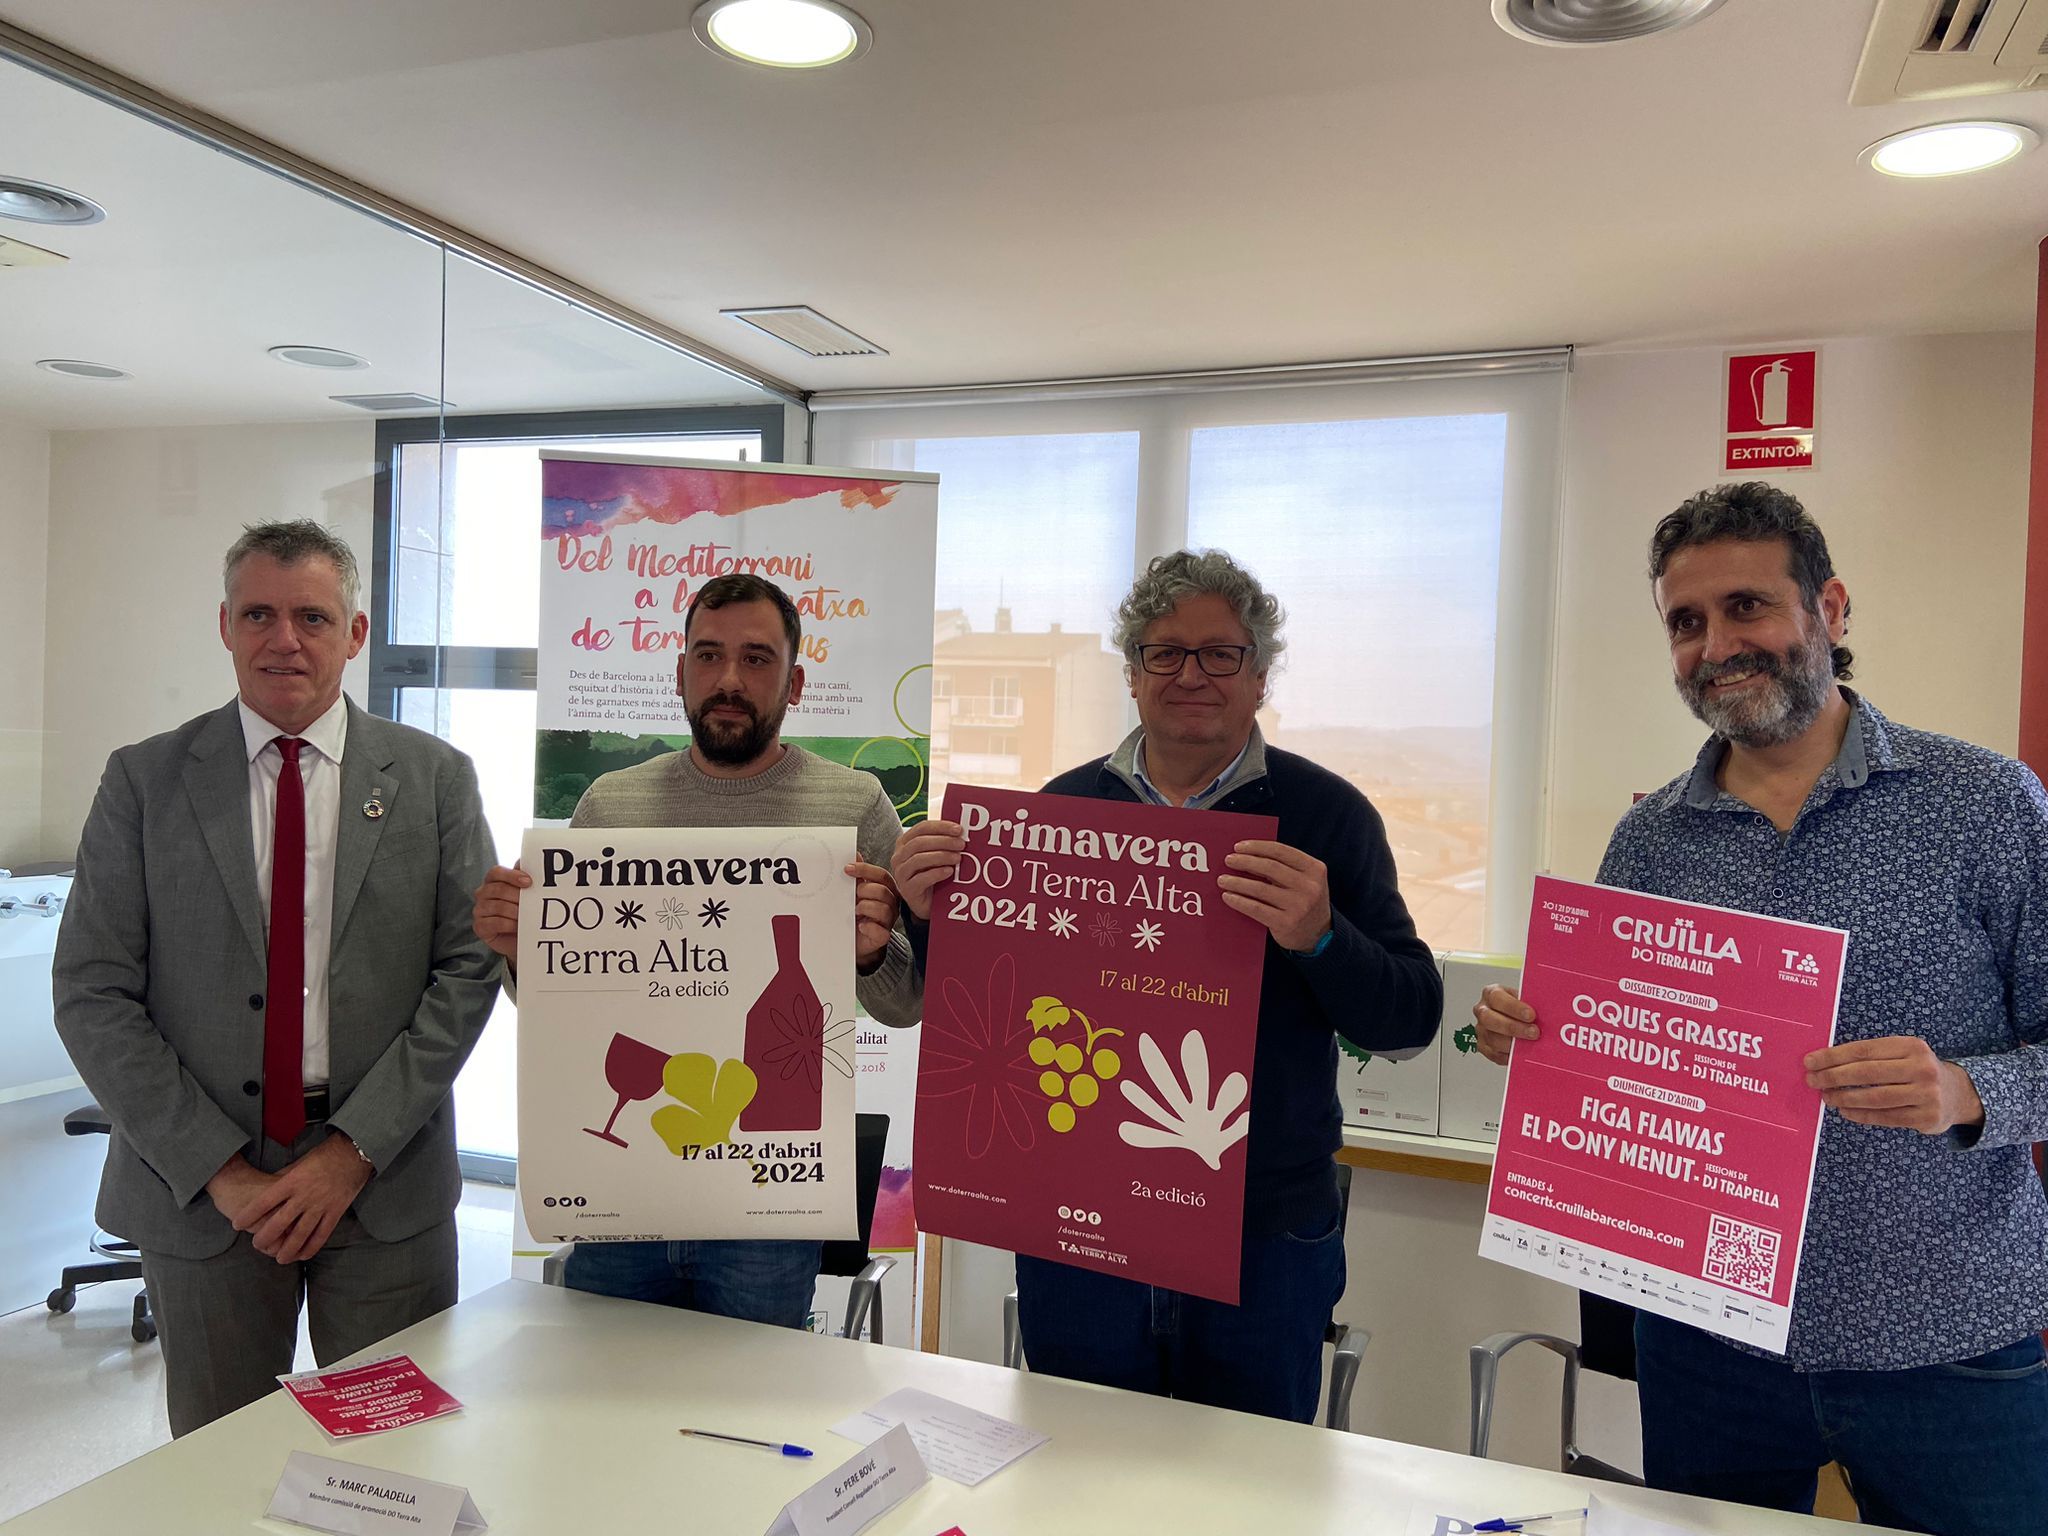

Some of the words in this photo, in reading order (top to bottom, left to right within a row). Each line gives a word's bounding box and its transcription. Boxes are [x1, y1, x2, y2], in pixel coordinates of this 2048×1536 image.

[1732, 445, 1806, 460] EXTINTOR
[558, 533, 613, 573] Del
[628, 542, 815, 581] Mediterrani
[634, 588, 658, 609] a
[572, 617, 614, 651] de
[570, 670, 587, 679] Des
[589, 670, 600, 680] de
[603, 671, 646, 681] Barcelona
[657, 673, 664, 682] la
[568, 695, 579, 704] de
[582, 696, 594, 705] les
[596, 698, 639, 707] garnatxes
[642, 699, 660, 708] més
[802, 705, 810, 713] la
[813, 705, 844, 715] matèria
[569, 684, 609, 694] esquitxat
[825, 693, 844, 702] amb
[604, 709, 615, 719] de
[618, 710, 625, 719] la
[628, 710, 668, 720] Garnatxa
[671, 712, 681, 721] de
[960, 803, 1210, 872] Primavera
[542, 847, 802, 887] Primavera
[953, 851, 1014, 889] DO
[1022, 860, 1118, 905] Terra
[1124, 874, 1204, 917] Alta
[540, 897, 604, 930] DO
[947, 891, 1038, 931] 2024
[1542, 901, 1554, 910] 20
[537, 940, 640, 974] Terra
[648, 937, 730, 973] Alta
[1631, 946, 1654, 962] DO
[1656, 951, 1689, 971] TERRA
[1688, 957, 1714, 976] ALTA
[648, 981, 670, 997] 2a
[675, 980, 729, 997] edició
[1099, 969, 1119, 988] 17
[1120, 974, 1138, 992] al
[1141, 976, 1166, 997] 22
[1170, 980, 1230, 1007] d'abril
[1778, 973, 1799, 983] TERRA
[1800, 978, 1818, 987] ALTA
[1624, 981, 1660, 998] DISSABTE
[1661, 989, 1677, 1000] 20
[1679, 993, 1712, 1009] D'ABRIL
[856, 1032, 887, 1044] alitat
[1572, 994, 1661, 1034] OQUES
[1666, 1017, 1763, 1059] GRASSES
[1560, 1023, 1681, 1071] GERTRUDIS
[862, 1061, 886, 1072] 2018
[1694, 1053, 1726, 1068] SESSIONS
[1727, 1061, 1737, 1071] DE
[1692, 1064, 1706, 1079] DJ
[1709, 1069, 1769, 1095] TRAPELLA
[1613, 1079, 1656, 1097] DIUMENGE
[1656, 1089, 1666, 1101] 21
[1667, 1092, 1700, 1110] D'ABRIL
[1581, 1095, 1632, 1132] FIGA
[1637, 1110, 1725, 1156] FLAWAS
[681, 1144, 700, 1161] 17
[705, 1143, 723, 1160] al
[727, 1143, 753, 1160] 22
[758, 1142, 822, 1159] d'abril
[1521, 1112, 1541, 1140] EL
[1546, 1119, 1617, 1159] PONY
[1619, 1140, 1696, 1182] MENUT
[751, 1162, 825, 1184] 2024
[1507, 1171, 1545, 1191] ENTRADES
[1705, 1163, 1737, 1180] SESSIONS
[1737, 1172, 1748, 1181] DE
[928, 1183, 1007, 1204] www.doterraalta.com
[1131, 1181, 1151, 1199] 2a
[1155, 1186, 1206, 1208] edició
[1702, 1173, 1718, 1190] DJ
[1720, 1179, 1779, 1208] TRAPELLA
[1504, 1186, 1685, 1249] concerts.cruillabarcelona.com
[1080, 1250, 1105, 1260] TERRA
[1108, 1255, 1128, 1265] ALTA
[326, 1476, 337, 1488] Sr.
[339, 1479, 367, 1494] MARC
[367, 1485, 416, 1505] PALADELLA
[834, 1487, 845, 1498] Sr.
[843, 1473, 859, 1490] PERE
[859, 1459, 877, 1479] BOVÉ
[387, 1510, 396, 1518] DO
[397, 1512, 410, 1521] Terra
